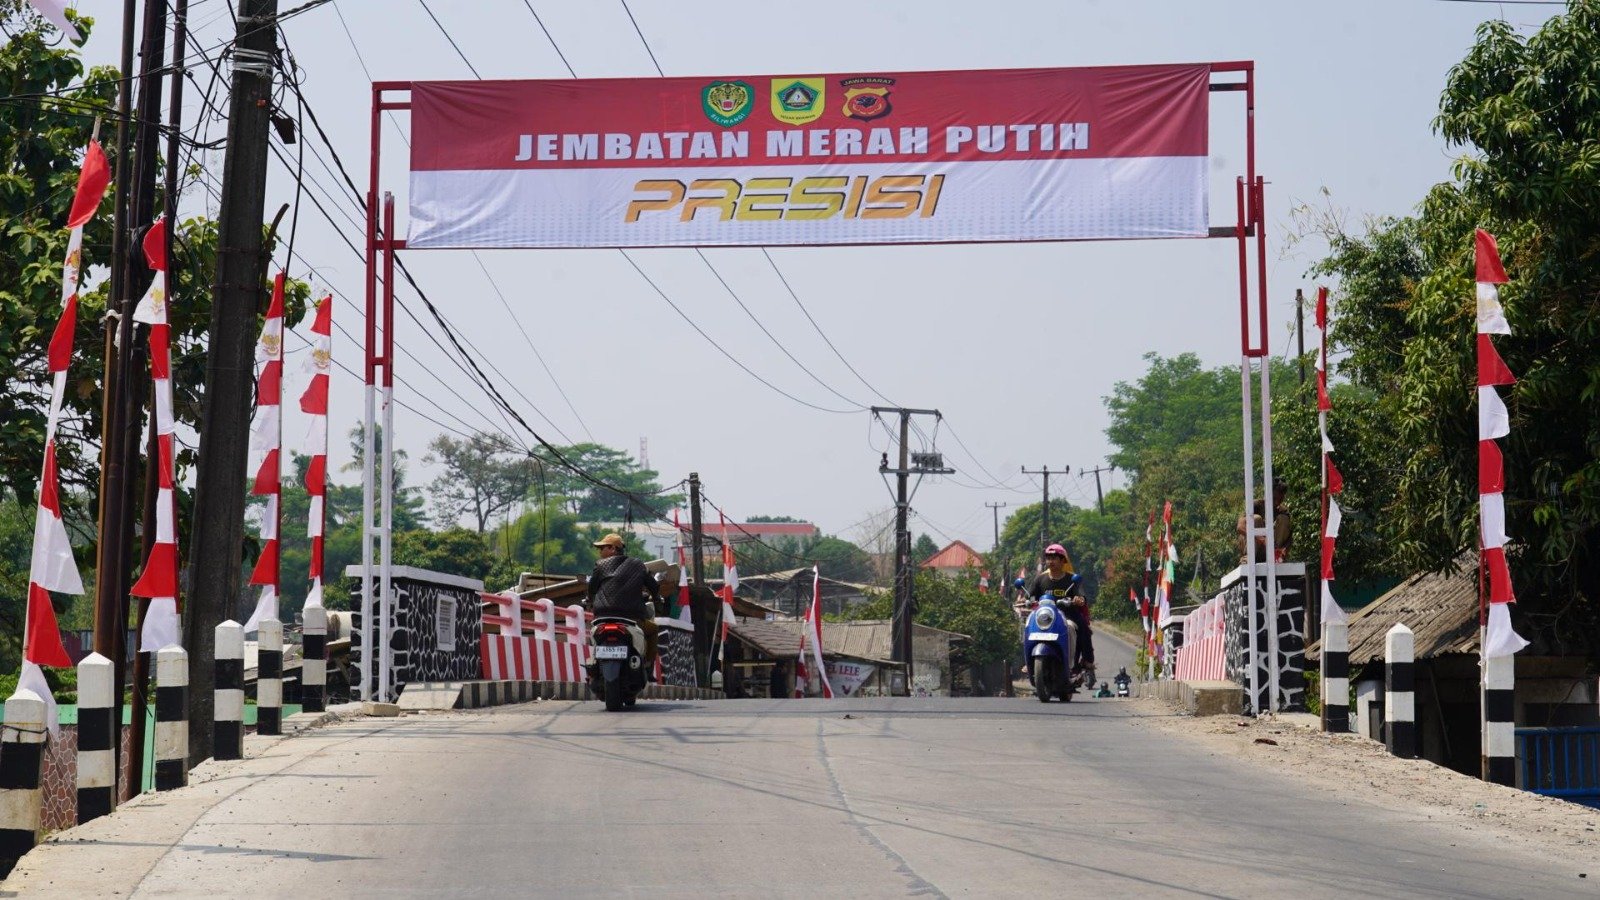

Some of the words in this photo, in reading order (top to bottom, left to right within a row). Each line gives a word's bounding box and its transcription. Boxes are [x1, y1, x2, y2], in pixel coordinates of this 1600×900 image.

[844, 78, 865, 86] JAWA
[710, 113, 746, 124] SILIWANGI
[515, 131, 749, 161] JEMBATAN
[766, 127, 928, 157] MERAH
[945, 122, 1089, 153] PUTIH
[624, 174, 946, 223] PRESISI
[839, 665, 860, 676] LELE
